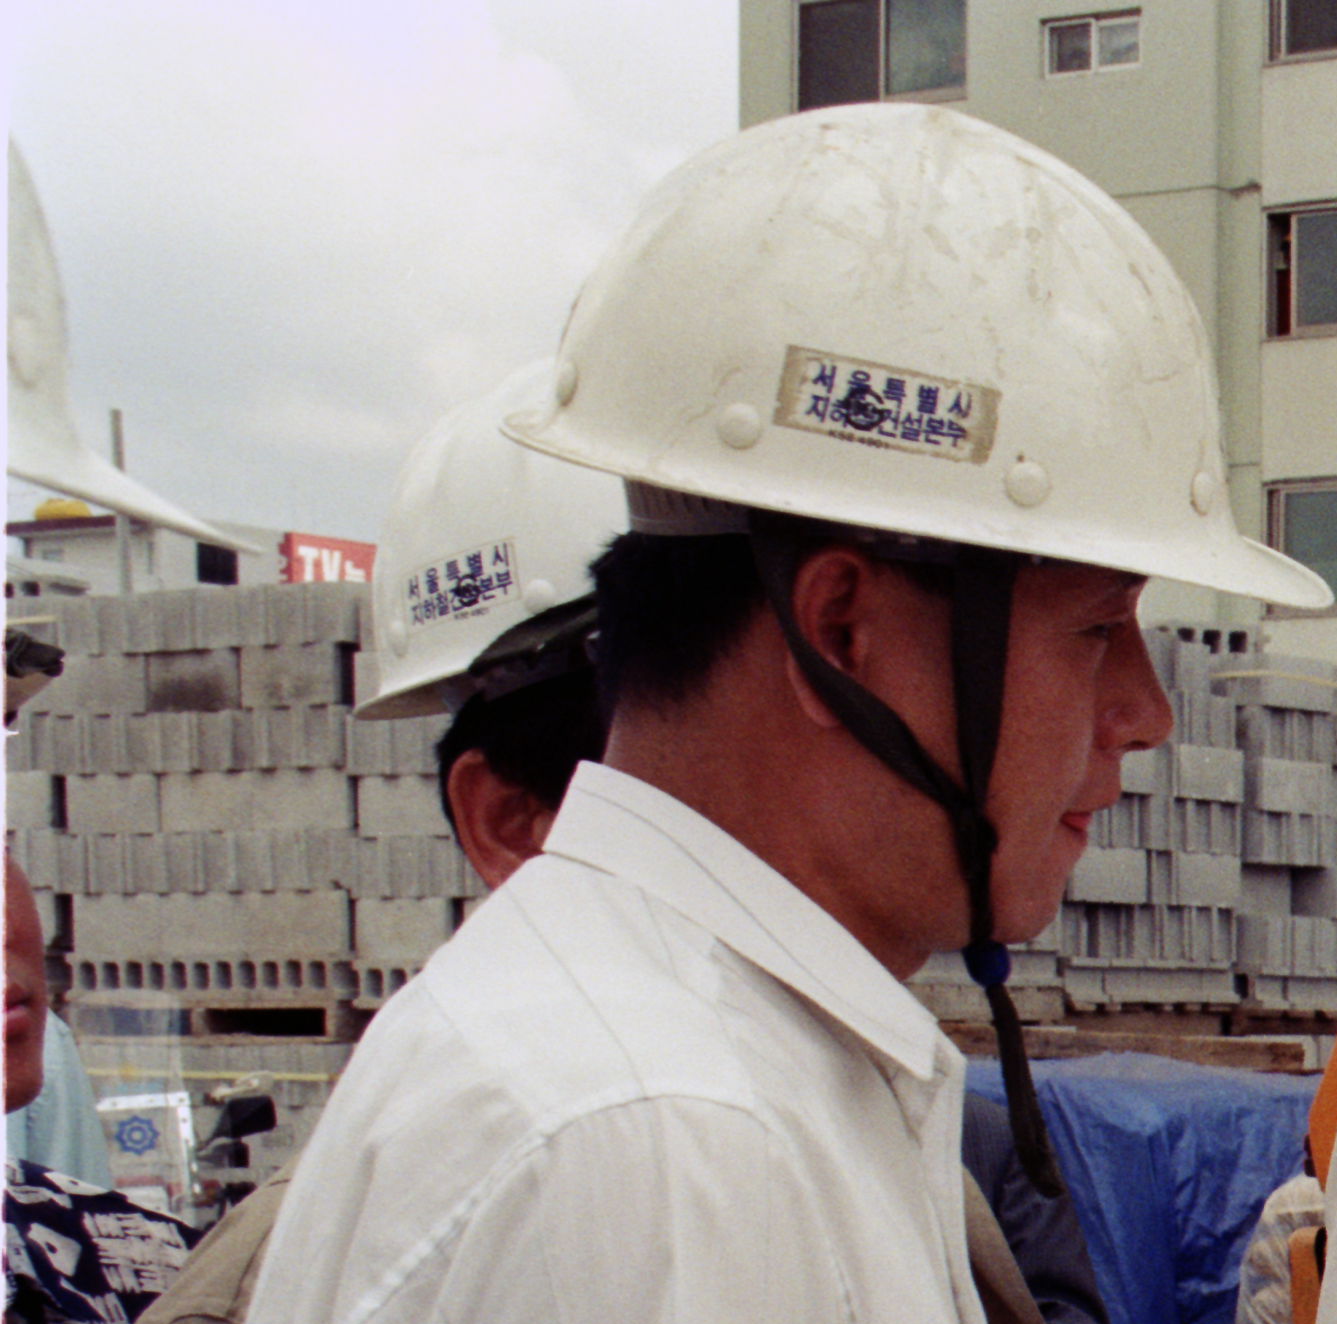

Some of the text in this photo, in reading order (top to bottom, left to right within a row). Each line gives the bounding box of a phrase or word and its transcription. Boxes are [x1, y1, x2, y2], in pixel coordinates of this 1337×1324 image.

[812, 364, 972, 418] 서울특별시
[805, 394, 968, 448] 지하건설본부
[408, 542, 509, 599] 서울특별시
[412, 570, 513, 625] 지하철본부
